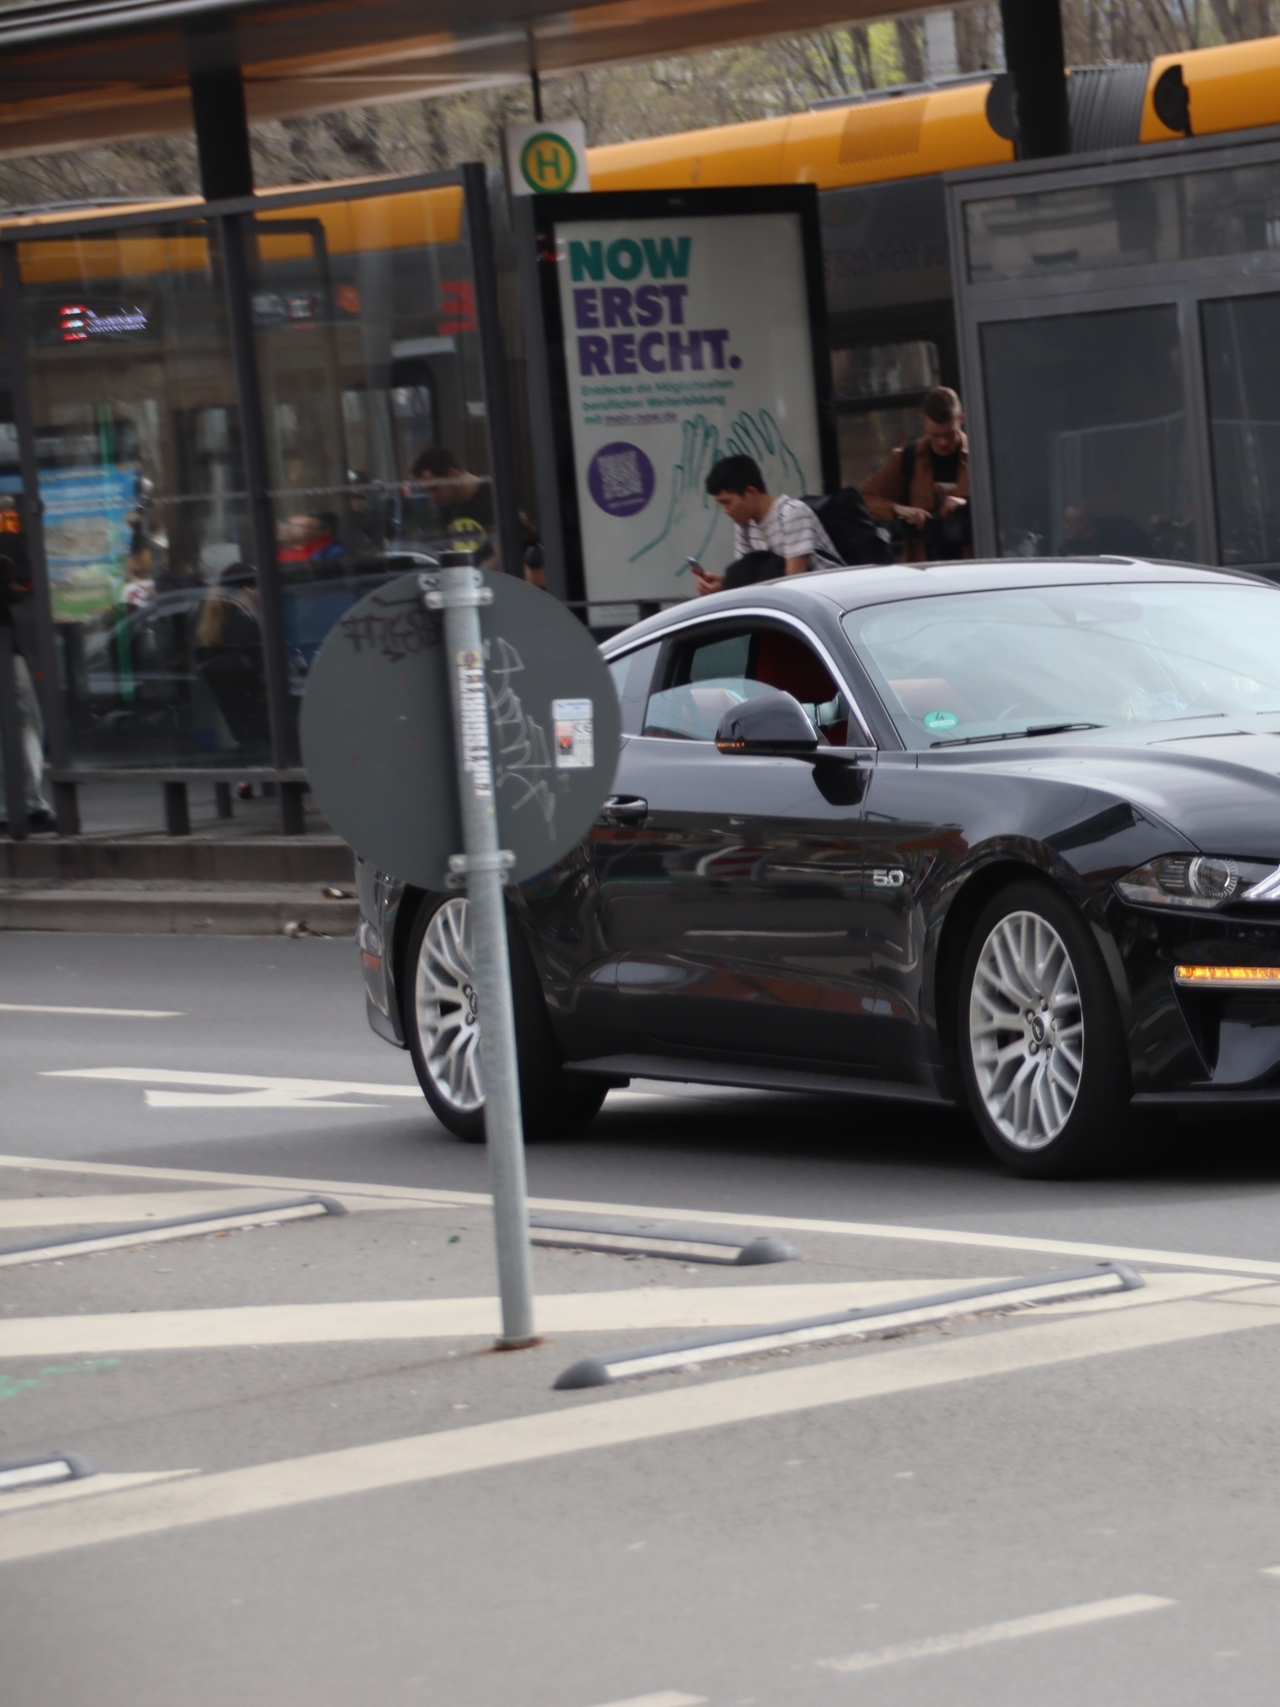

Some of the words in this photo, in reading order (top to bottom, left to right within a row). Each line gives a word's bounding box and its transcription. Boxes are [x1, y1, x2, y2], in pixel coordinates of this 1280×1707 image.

[536, 147, 563, 183] H
[568, 236, 692, 282] NOW
[573, 283, 689, 330] ERST
[577, 328, 743, 376] RECHT.
